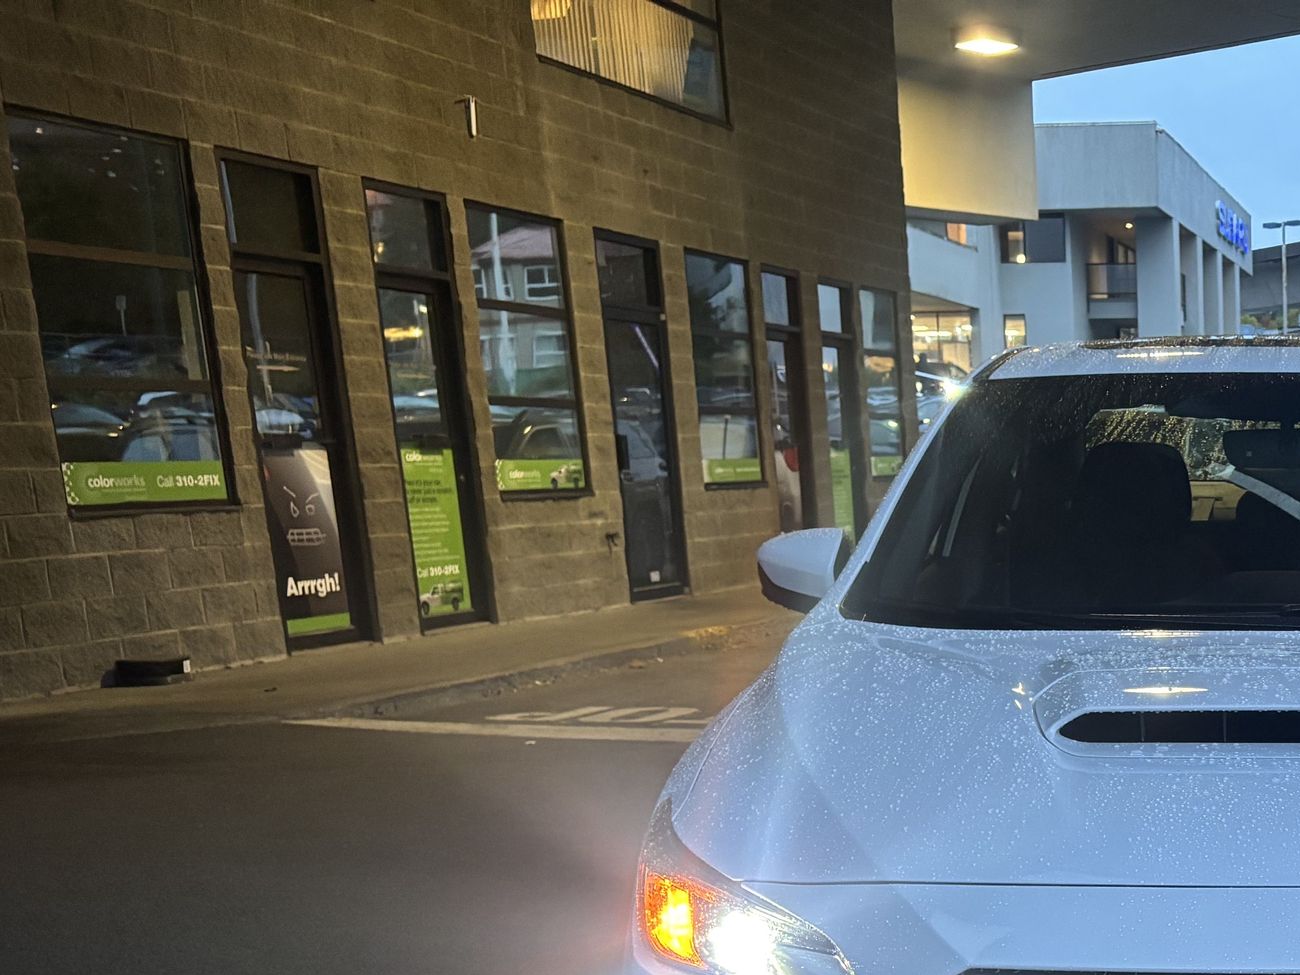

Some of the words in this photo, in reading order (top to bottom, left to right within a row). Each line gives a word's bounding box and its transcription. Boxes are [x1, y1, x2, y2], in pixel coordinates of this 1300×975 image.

[88, 474, 146, 489] colorworks
[156, 474, 174, 488] Call
[286, 571, 341, 598] Arrrgh!
